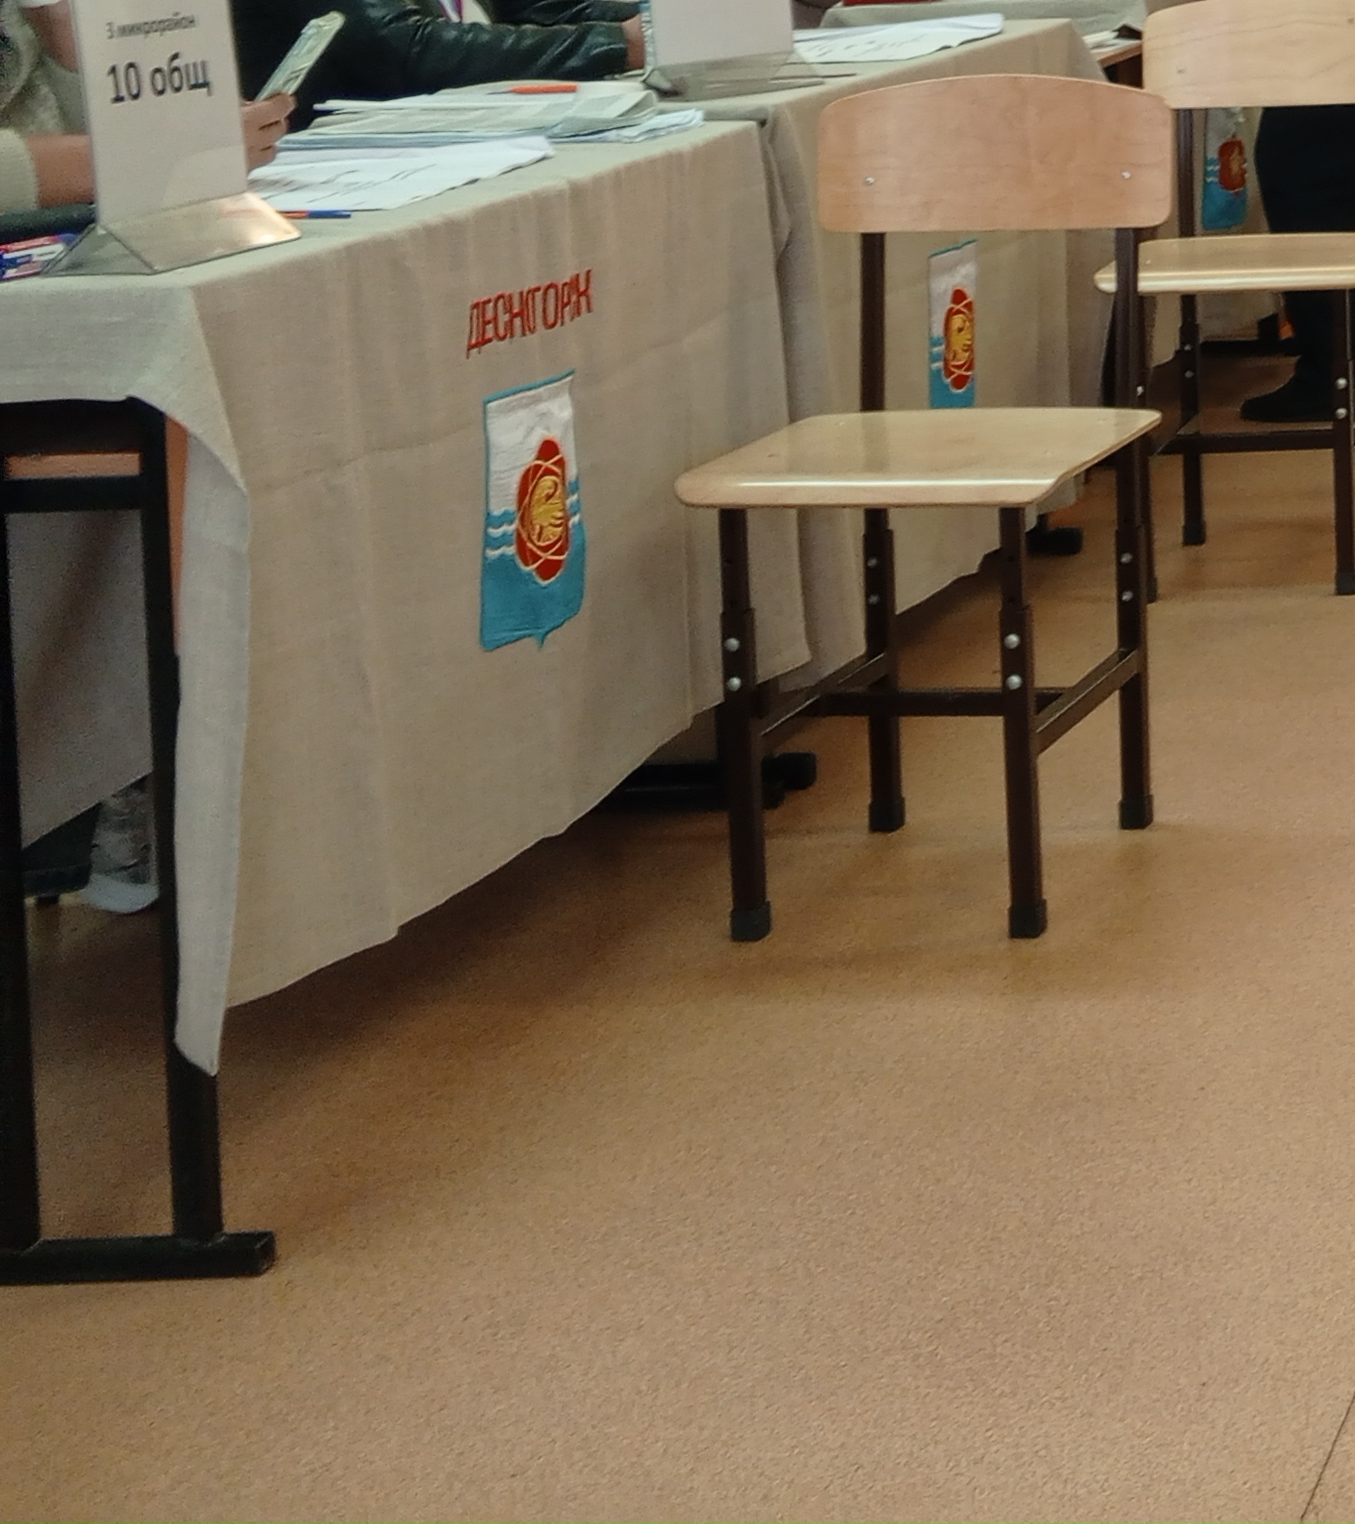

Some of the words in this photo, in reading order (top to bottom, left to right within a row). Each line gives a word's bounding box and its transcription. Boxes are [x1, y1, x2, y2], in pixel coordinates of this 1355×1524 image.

[106, 22, 115, 39] 3
[117, 12, 196, 39] микрорайон
[107, 61, 142, 104] 10
[150, 52, 213, 97] общ
